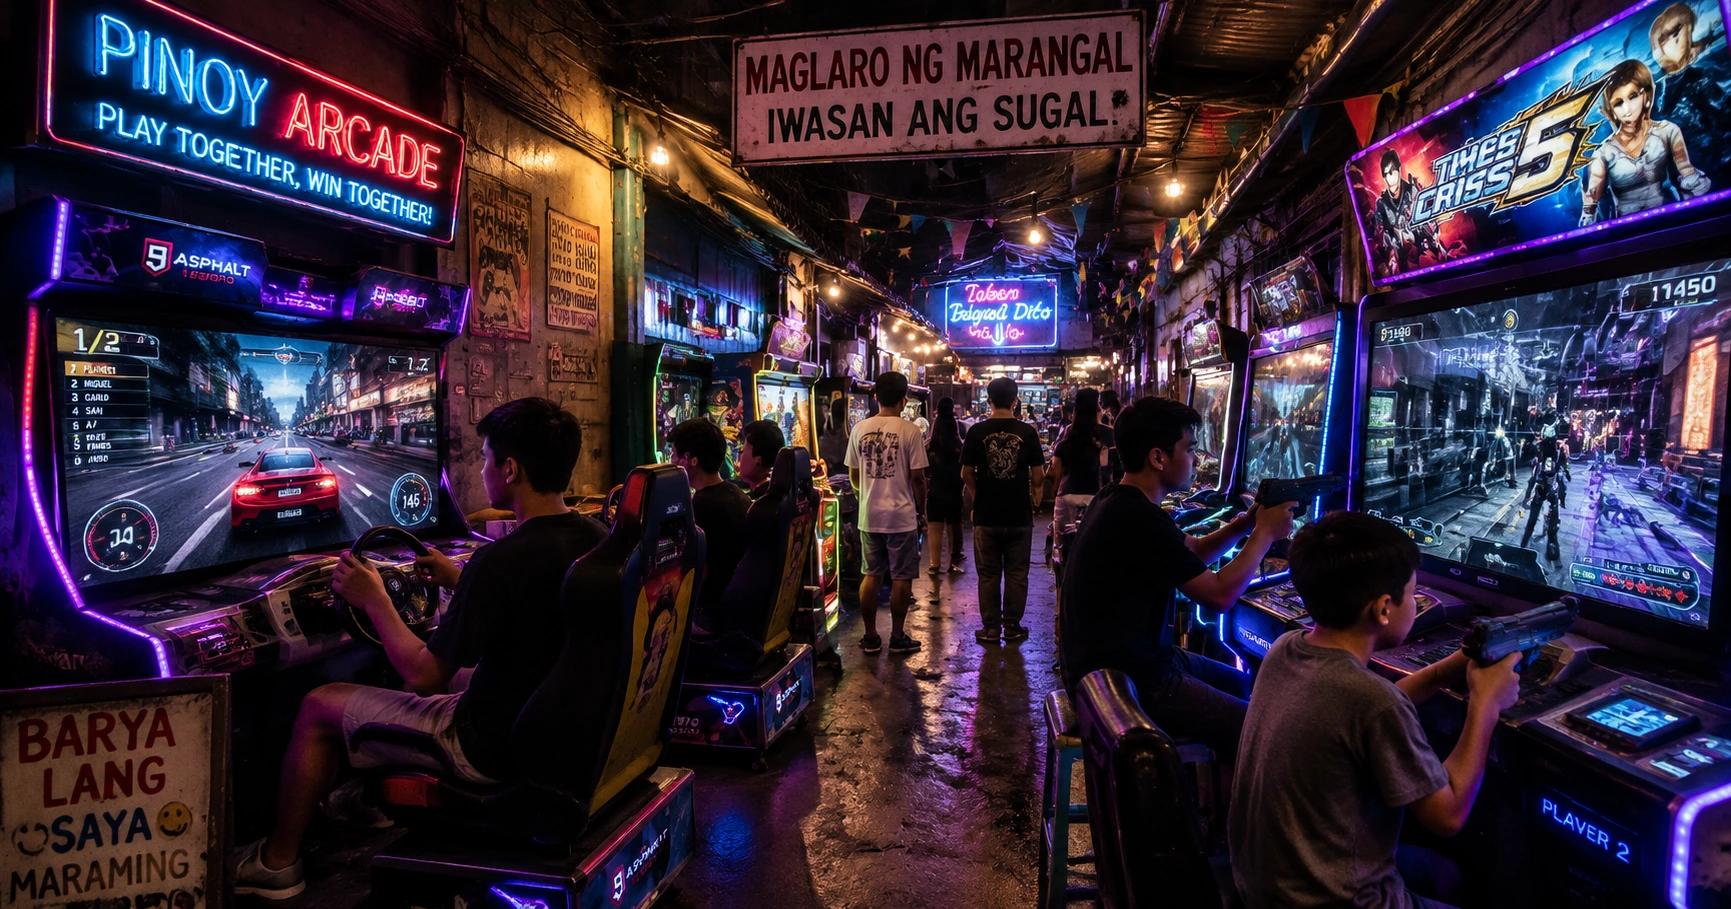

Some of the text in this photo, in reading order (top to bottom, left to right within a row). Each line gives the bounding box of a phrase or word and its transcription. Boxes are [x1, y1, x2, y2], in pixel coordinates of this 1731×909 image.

[745, 31, 1133, 96] MAGLARO NG MARANGAL
[94, 13, 442, 189] PINOY ARCADE
[768, 90, 1119, 145] IWASAN ANG SUGAL.
[96, 102, 168, 146] PLAY
[176, 126, 301, 189] TOGETHER,
[306, 168, 342, 198] WIN
[348, 181, 434, 226] TOGETHER!
[1502, 89, 1596, 204] 5
[146, 244, 168, 272] 9
[173, 252, 251, 277] ASPHALT
[1013, 301, 1053, 320] Dito
[1652, 275, 1716, 302] 11450
[71, 379, 78, 388] 2
[71, 393, 79, 402] 3
[72, 407, 79, 415] 4
[18, 707, 176, 764] BARYA
[43, 756, 166, 808] LANG
[51, 807, 152, 854] SAYA
[1616, 841, 1630, 864] 2
[9, 849, 190, 905] MARAMING
